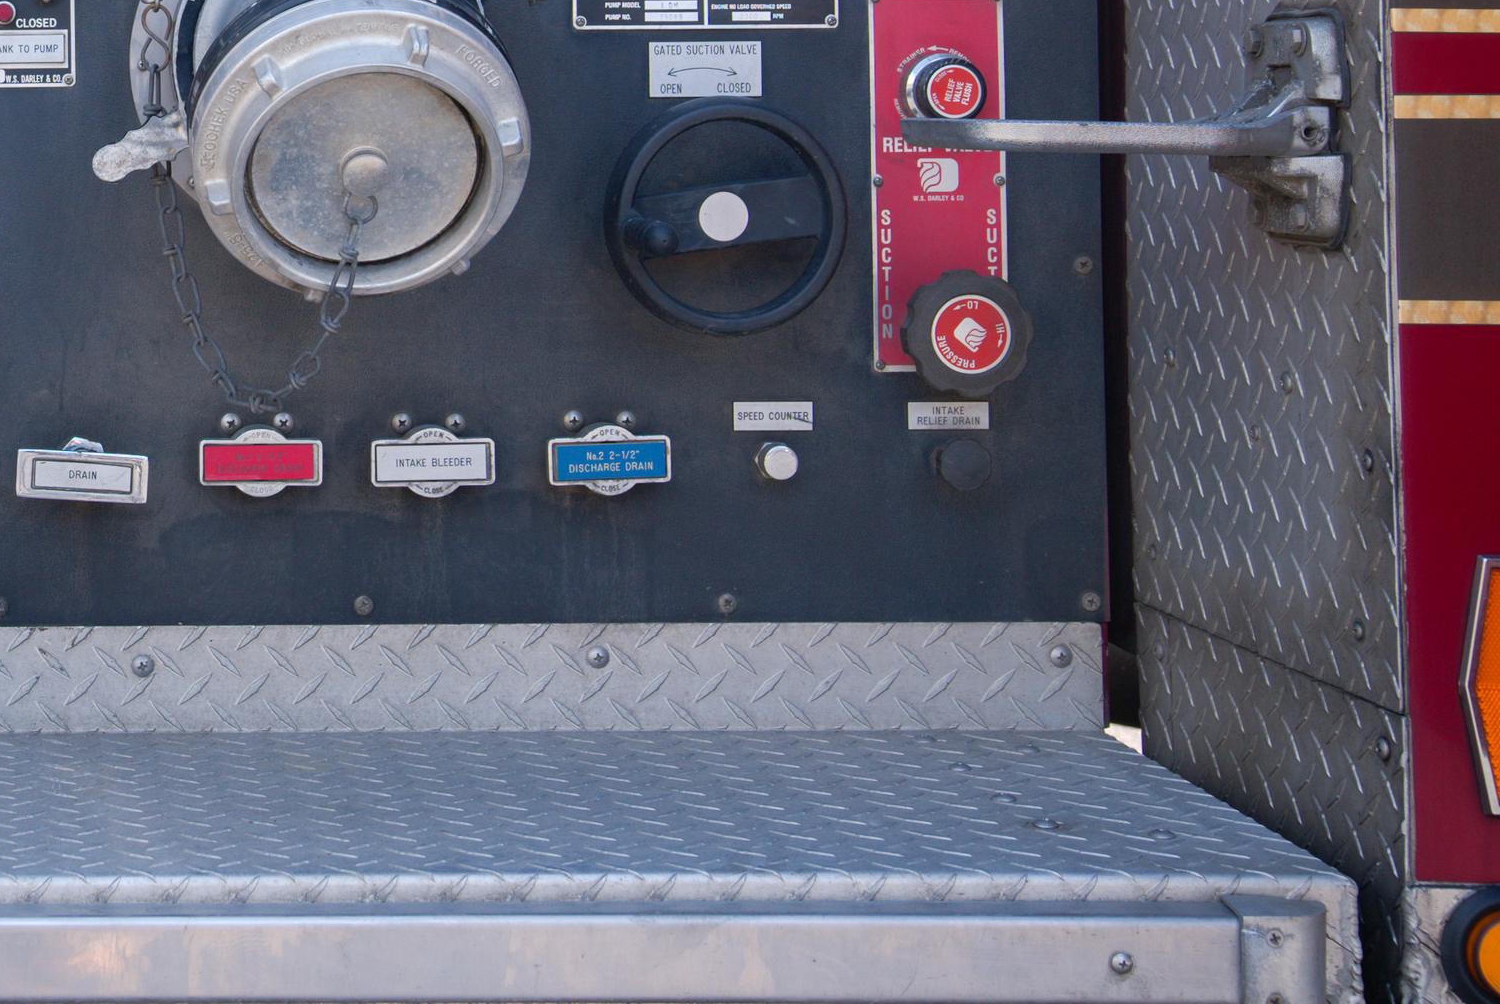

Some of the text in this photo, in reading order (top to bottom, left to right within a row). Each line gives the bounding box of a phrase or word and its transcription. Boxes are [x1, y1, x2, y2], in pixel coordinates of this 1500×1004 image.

[16, 18, 57, 28] CLOSED
[34, 44, 58, 52] PUMP
[654, 44, 757, 55] GATED SUCTION VALVE
[21, 75, 43, 83] DARLEY
[660, 84, 682, 94] OPEN
[717, 83, 751, 93] CLOSED
[881, 210, 893, 339] SUCTION
[937, 335, 976, 368] PRESSURE
[738, 412, 809, 420] SPEED COUNTER
[932, 407, 964, 415] INTAKE
[917, 417, 980, 425] RELIEF DRAIN
[396, 458, 472, 468] INTAKE BLEEDER
[569, 461, 653, 473] DISCHARGE DRAIN
[69, 469, 97, 481] DRAIN
